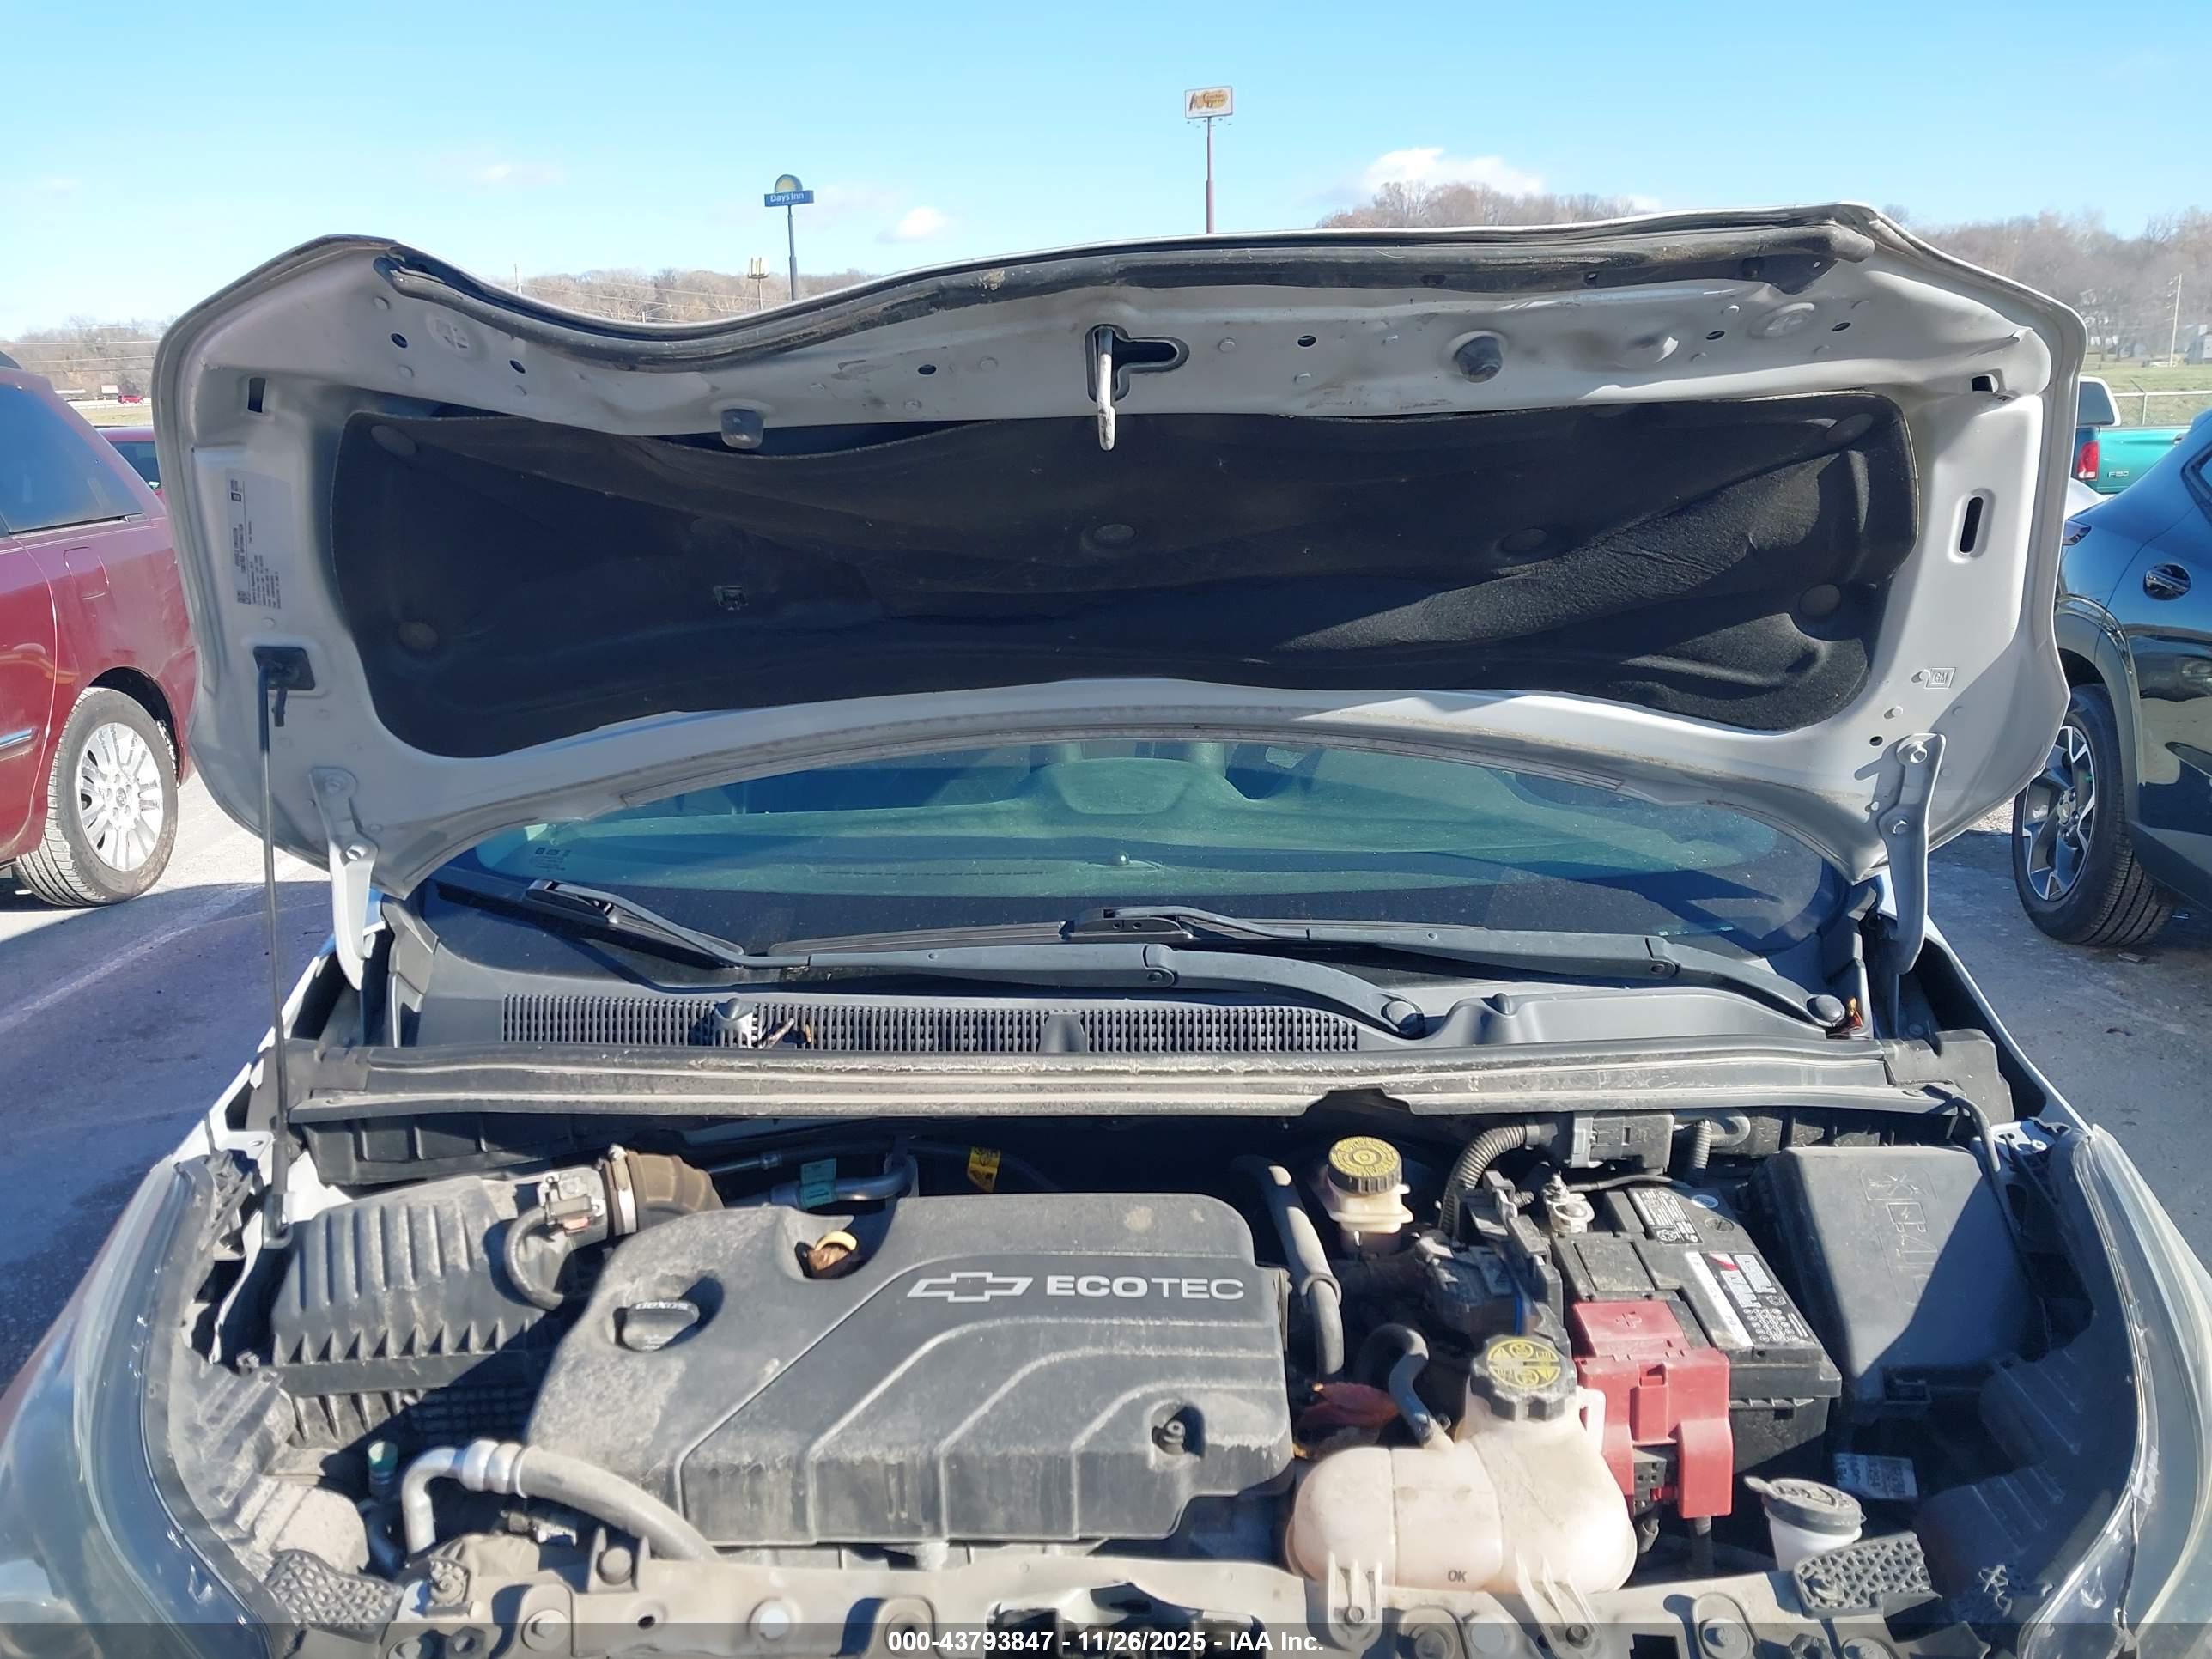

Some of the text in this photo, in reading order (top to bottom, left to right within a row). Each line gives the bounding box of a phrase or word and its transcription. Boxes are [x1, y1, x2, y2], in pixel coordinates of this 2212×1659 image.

[769, 192, 805, 203] Days Inn
[1931, 672, 1950, 684] GM
[1046, 1274, 1245, 1300] ECOTEC
[1448, 1569, 1468, 1583] OK
